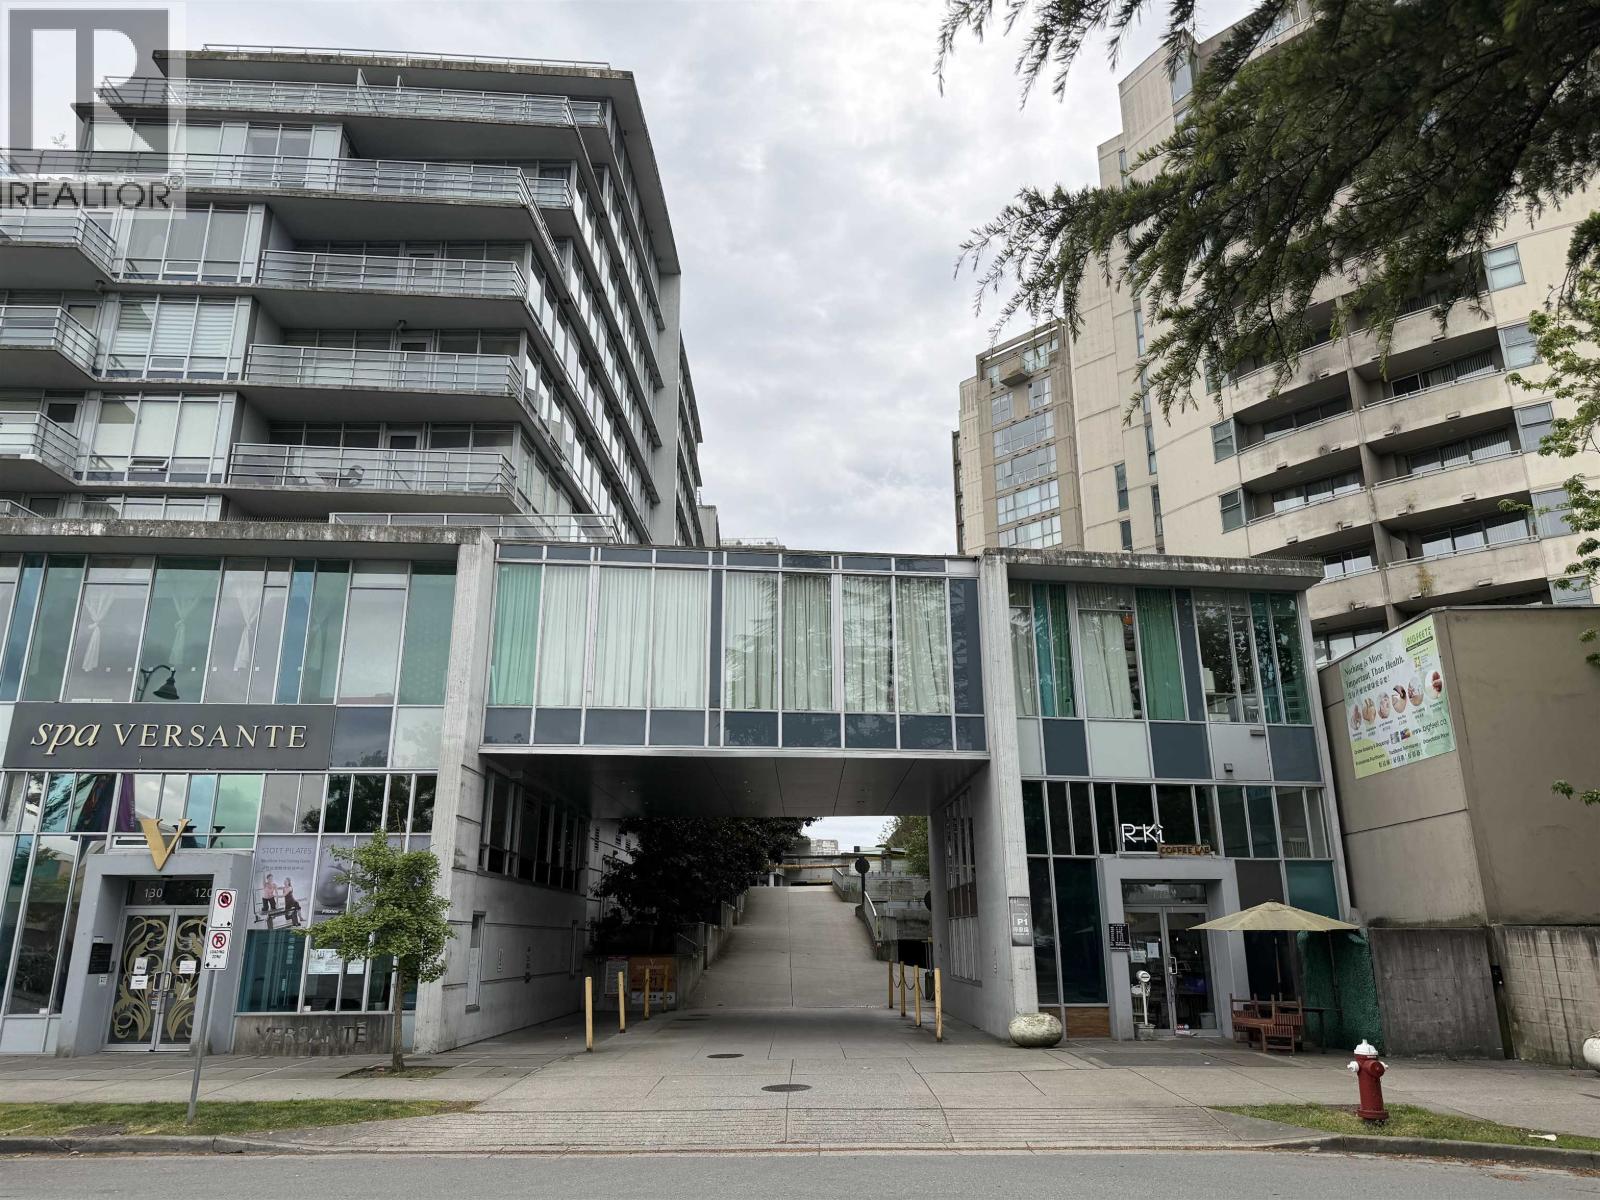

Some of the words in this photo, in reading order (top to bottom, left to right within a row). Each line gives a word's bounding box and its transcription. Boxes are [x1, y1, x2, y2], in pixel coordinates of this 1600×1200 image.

[1344, 660, 1363, 676] Nothing
[1369, 653, 1383, 666] More
[1345, 672, 1371, 690] Important
[1371, 665, 1384, 678] Than
[31, 722, 102, 756] spa
[113, 723, 308, 749] VERSANTE
[138, 817, 192, 871] V
[285, 847, 312, 855] PILATES
[1160, 846, 1192, 855] COFFEE
[1193, 845, 1211, 855] LAB
[144, 888, 163, 898] 130
[195, 888, 212, 898] 120
[1017, 918, 1028, 926] P1
